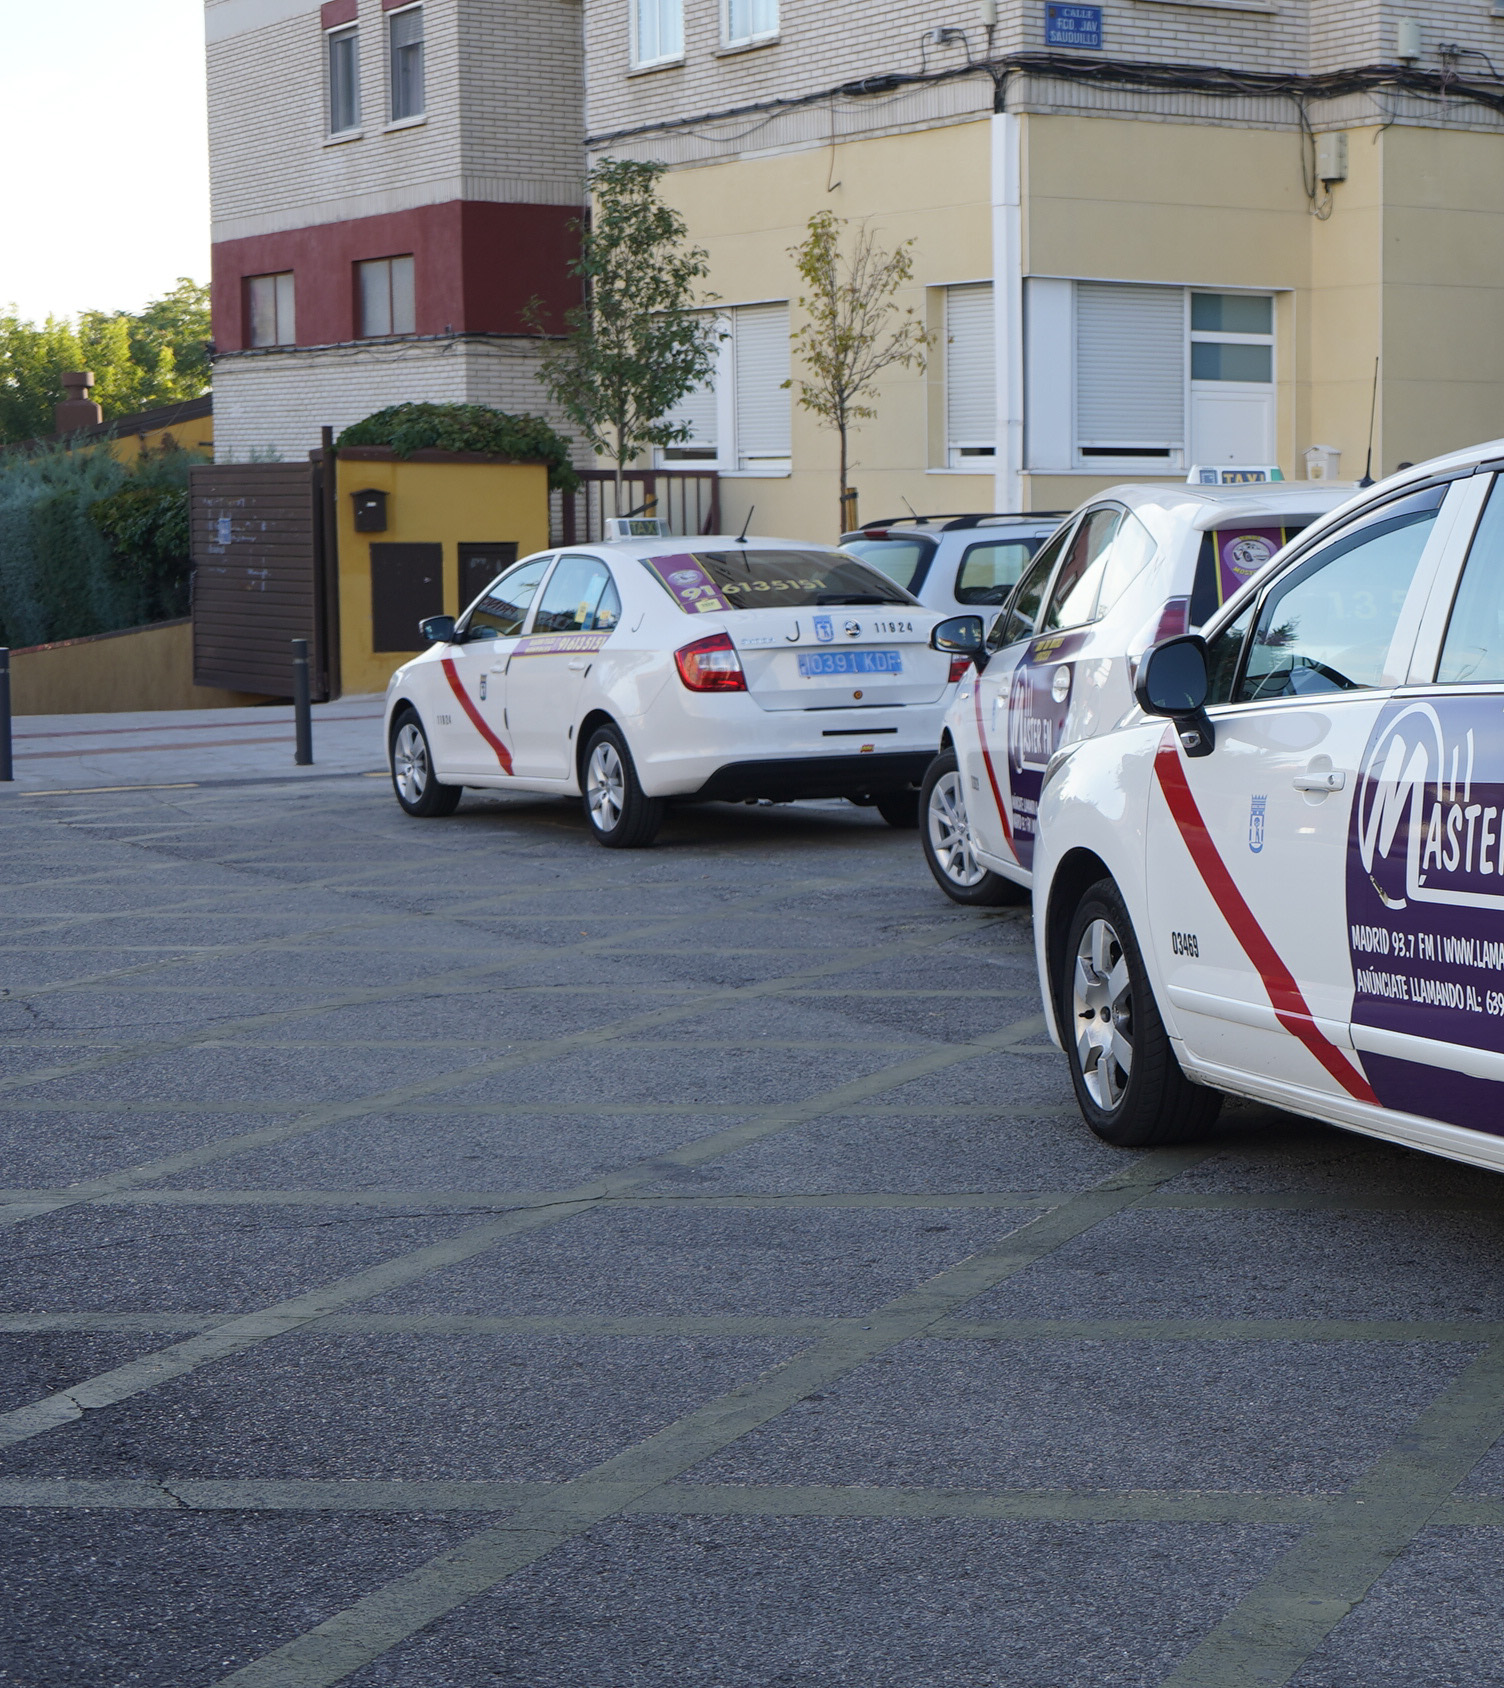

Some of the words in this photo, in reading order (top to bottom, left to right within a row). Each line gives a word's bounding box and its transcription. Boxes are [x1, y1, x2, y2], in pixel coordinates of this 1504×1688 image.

[1063, 8, 1094, 18] CALLE
[680, 585, 716, 601] 91
[811, 653, 859, 673] 0391
[864, 652, 898, 671] KDF
[1171, 931, 1199, 958] 03469
[1351, 925, 1389, 955] MADRID
[1391, 931, 1415, 958] 93.7
[1418, 933, 1435, 961] FM
[1357, 966, 1409, 1000] ANÚNCIATE
[1409, 977, 1465, 1010] LLAMANDO
[1466, 985, 1483, 1013] AL:
[1486, 990, 1504, 1017] 639
